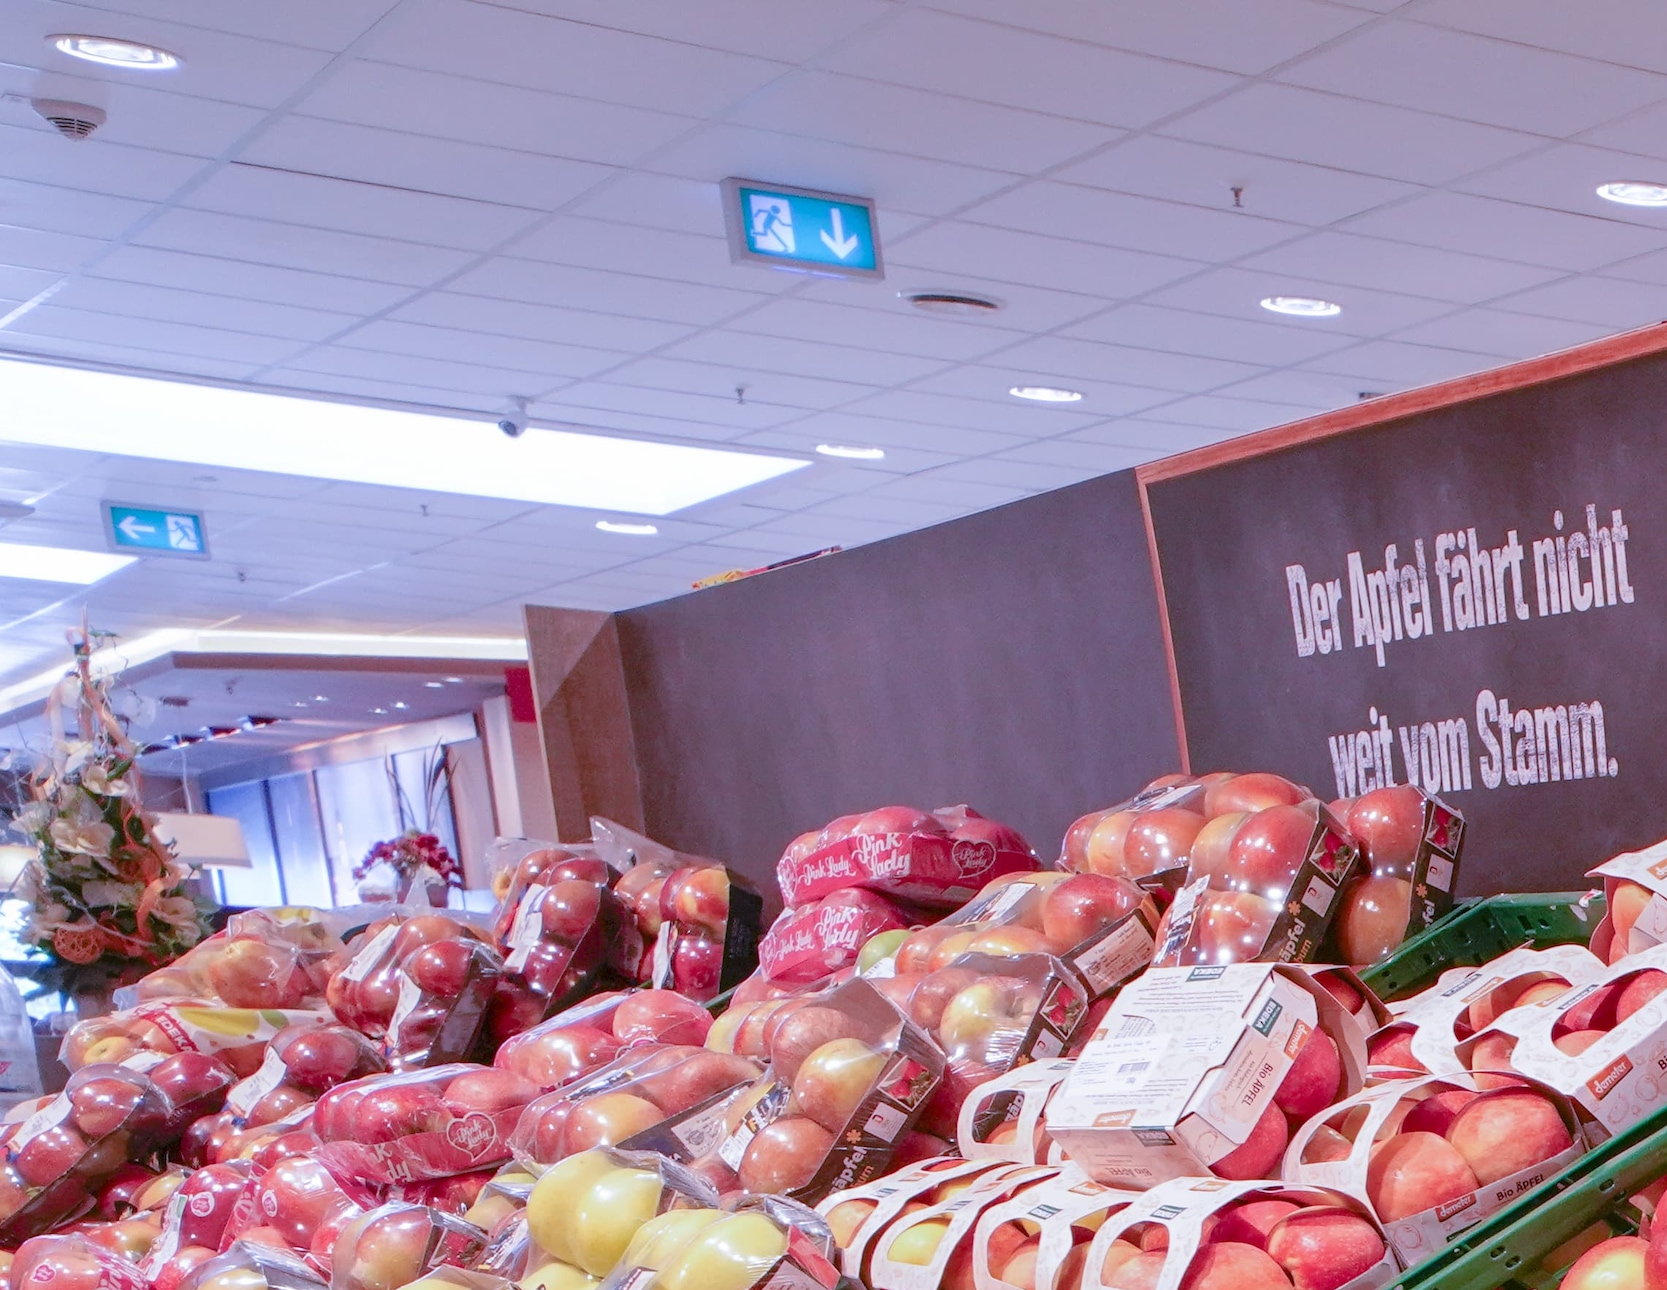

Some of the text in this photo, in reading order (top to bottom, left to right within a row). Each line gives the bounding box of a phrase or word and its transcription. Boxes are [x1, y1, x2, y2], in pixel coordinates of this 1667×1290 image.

[1286, 503, 1635, 667] Der Apfel fährt nicht
[1328, 689, 1618, 799] weit vom Stamm.
[852, 832, 912, 880] Pink Lady
[954, 847, 987, 862] Pink
[799, 863, 827, 885] Pink
[823, 855, 857, 878] Lady
[1192, 966, 1225, 979] EDEKA
[1256, 1001, 1277, 1028] EDEKA
[1258, 1063, 1274, 1079] Bio
[1593, 1060, 1628, 1094] demeter
[1241, 1079, 1265, 1106] ÄPFEL
[456, 1119, 491, 1149] Pink Lady
[1440, 1195, 1472, 1217] demeter
[1496, 1189, 1514, 1201] Bio
